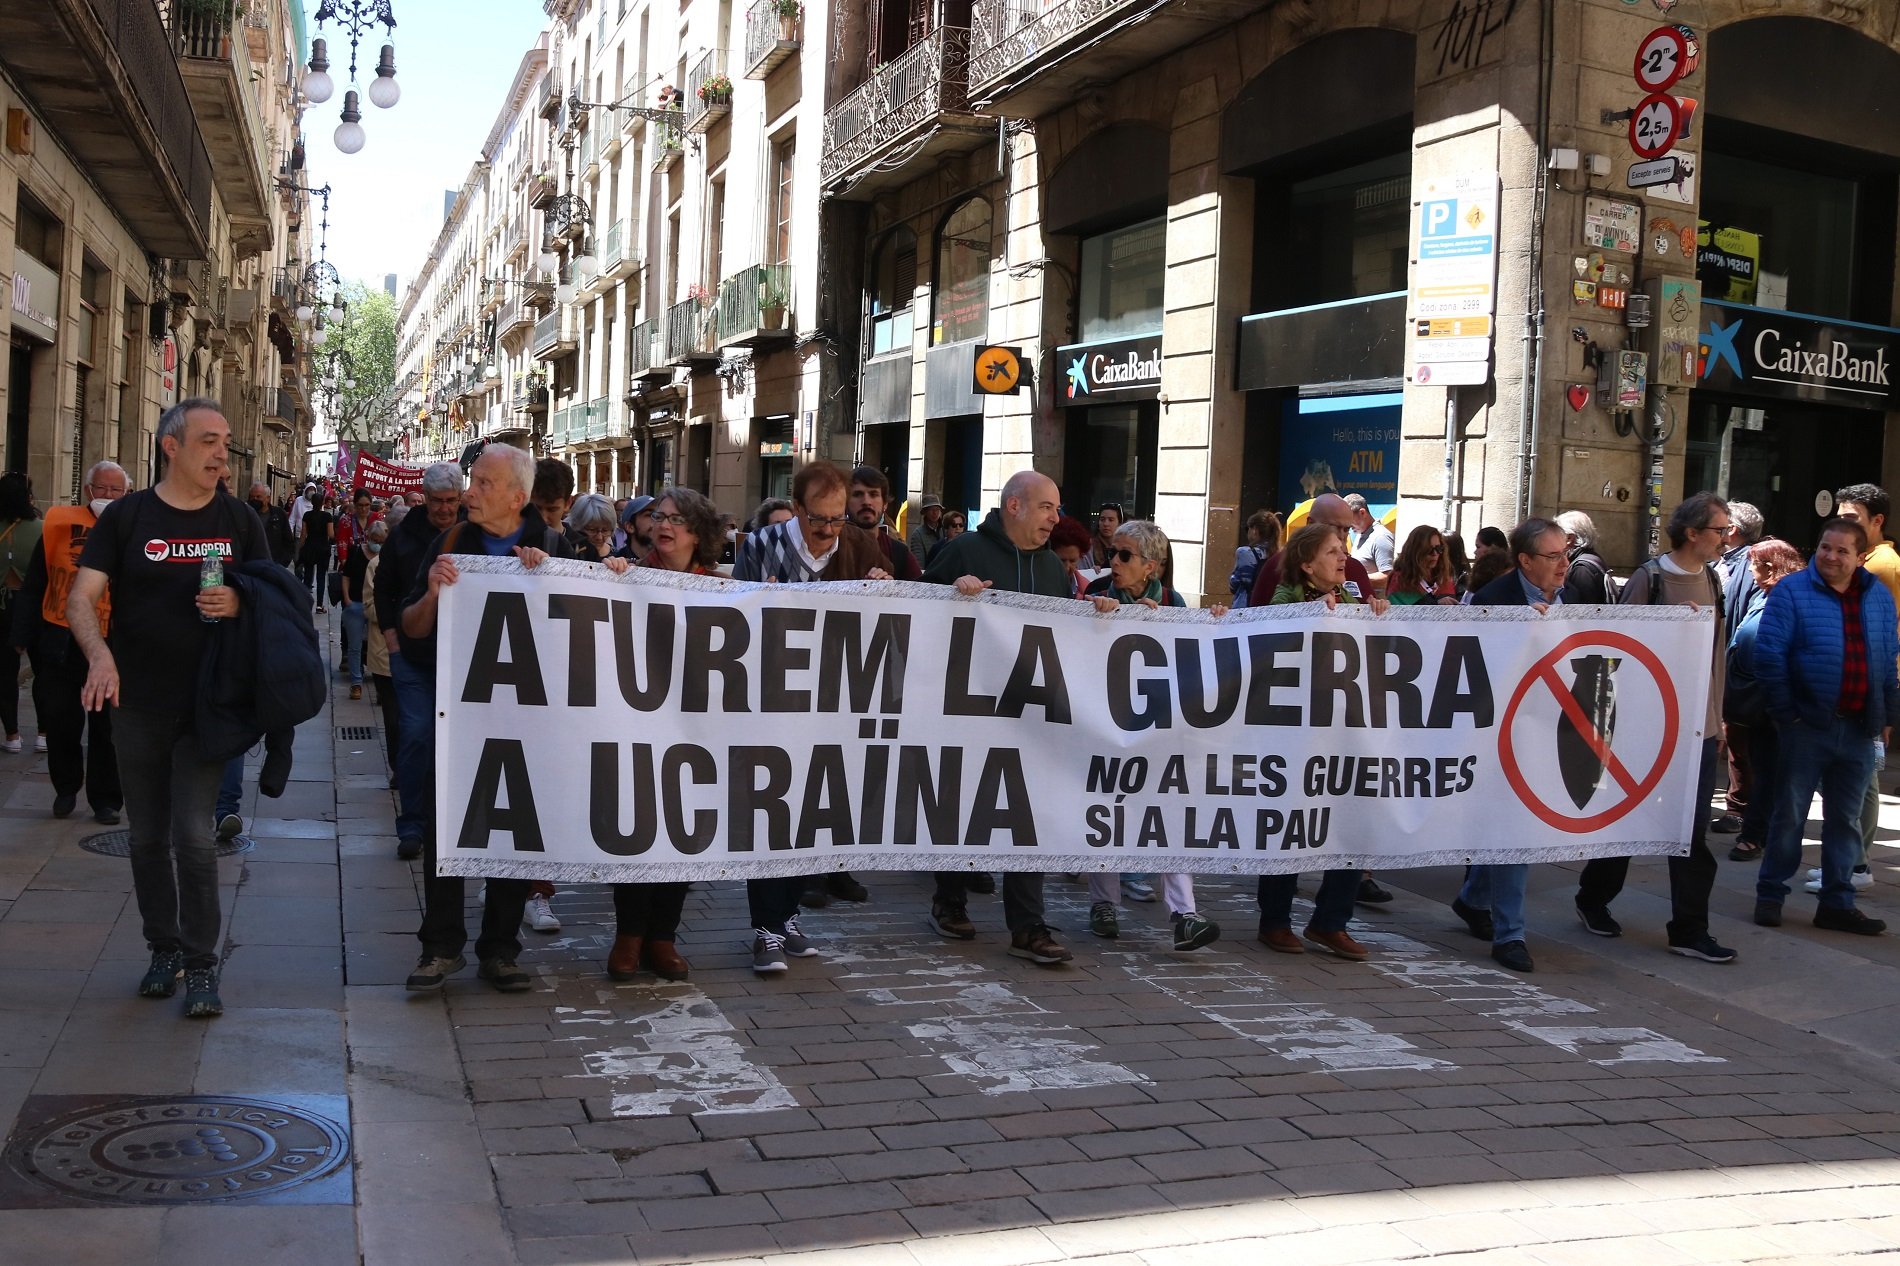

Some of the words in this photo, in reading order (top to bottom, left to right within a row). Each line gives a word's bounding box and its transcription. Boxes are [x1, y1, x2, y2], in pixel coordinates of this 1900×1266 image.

[1428, 202, 1450, 235] P
[1600, 208, 1627, 220] CARRER
[1091, 348, 1162, 384] CaixaBank
[1754, 328, 1890, 386] CaixaBank
[1357, 426, 1373, 442] this
[1374, 427, 1382, 440] is
[363, 469, 388, 484] SUPORT
[395, 477, 403, 485] LA
[1348, 450, 1383, 473] ATM
[172, 543, 185, 557] LA
[461, 592, 911, 714] ATUREM
[943, 617, 1072, 725] LA
[1106, 631, 1495, 731] GUERRA
[457, 738, 545, 852] A
[590, 719, 1038, 856] UCRAÏNA
[1086, 754, 1148, 795] NO
[1157, 754, 1190, 795] A
[1205, 753, 1288, 798] LES
[1303, 754, 1477, 799] GUERRES
[1086, 795, 1126, 848] SÍ
[1137, 805, 1169, 848] A
[1184, 806, 1241, 850] LA
[1255, 806, 1331, 851] PAU
